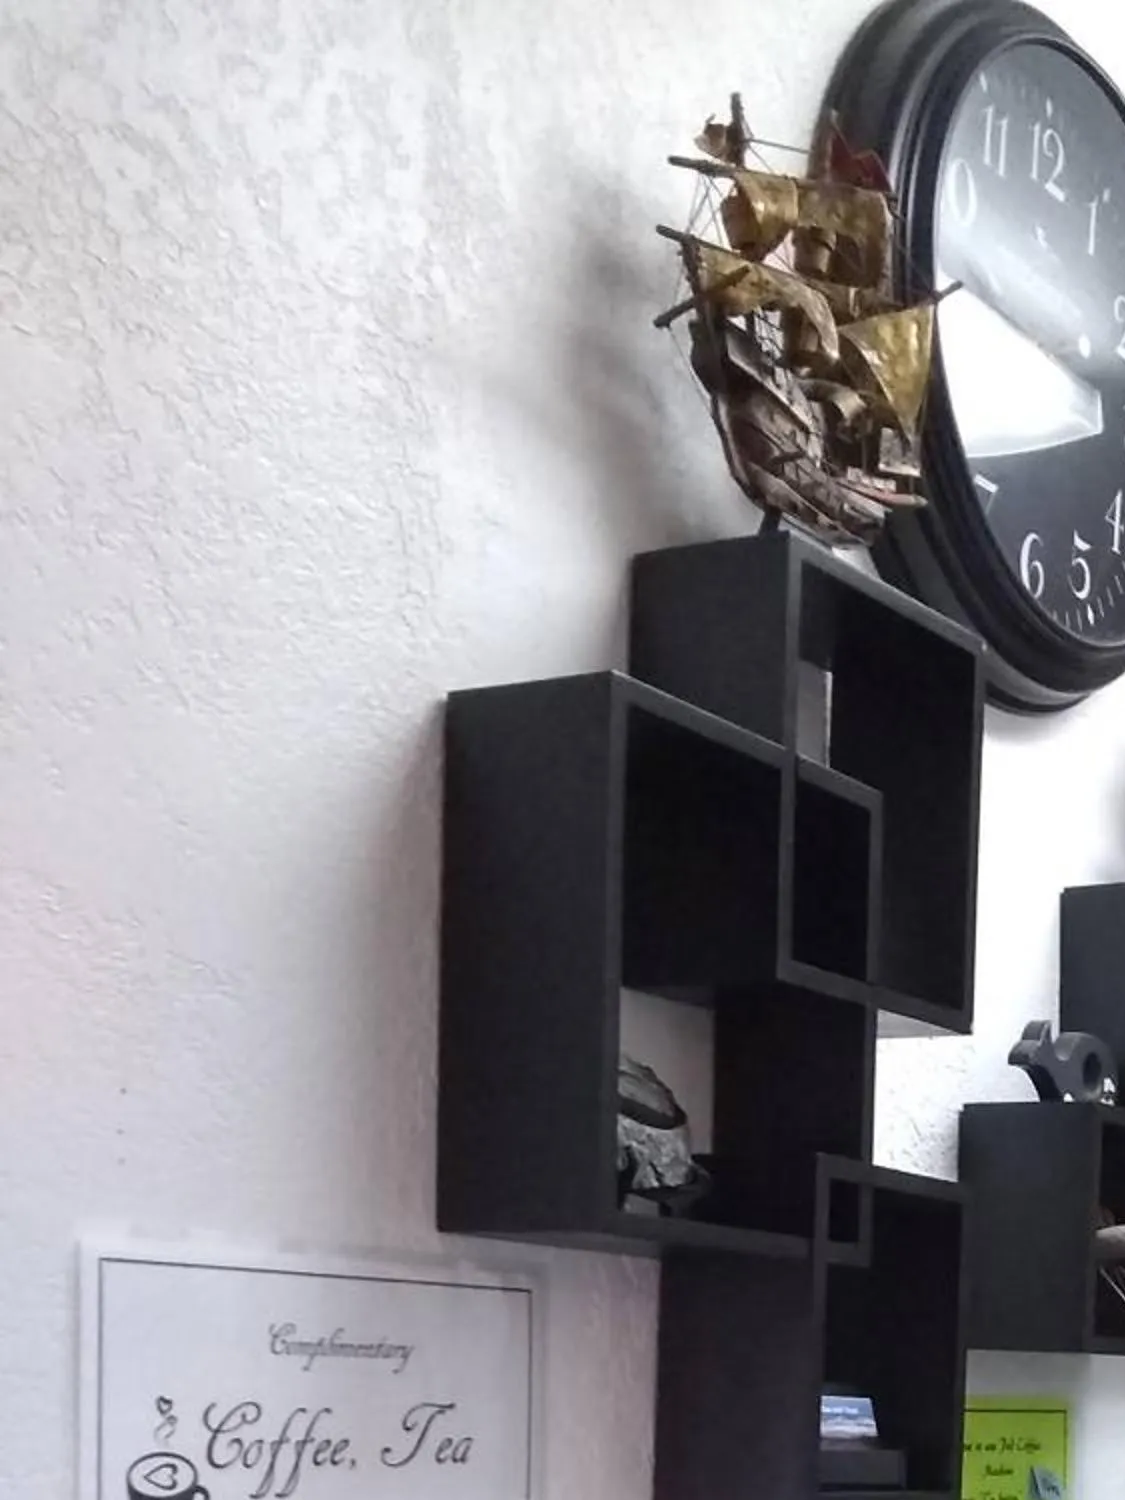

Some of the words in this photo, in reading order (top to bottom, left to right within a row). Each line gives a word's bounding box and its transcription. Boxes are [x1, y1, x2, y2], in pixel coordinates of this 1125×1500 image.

[980, 104, 1010, 179] 11
[1028, 121, 1069, 203] 12
[1085, 195, 1101, 257] 1
[1104, 490, 1125, 555] 4
[1019, 532, 1047, 600] 6
[1067, 530, 1093, 600] 5
[202, 1400, 359, 1500] Coffee,
[380, 1401, 476, 1468] Tea
